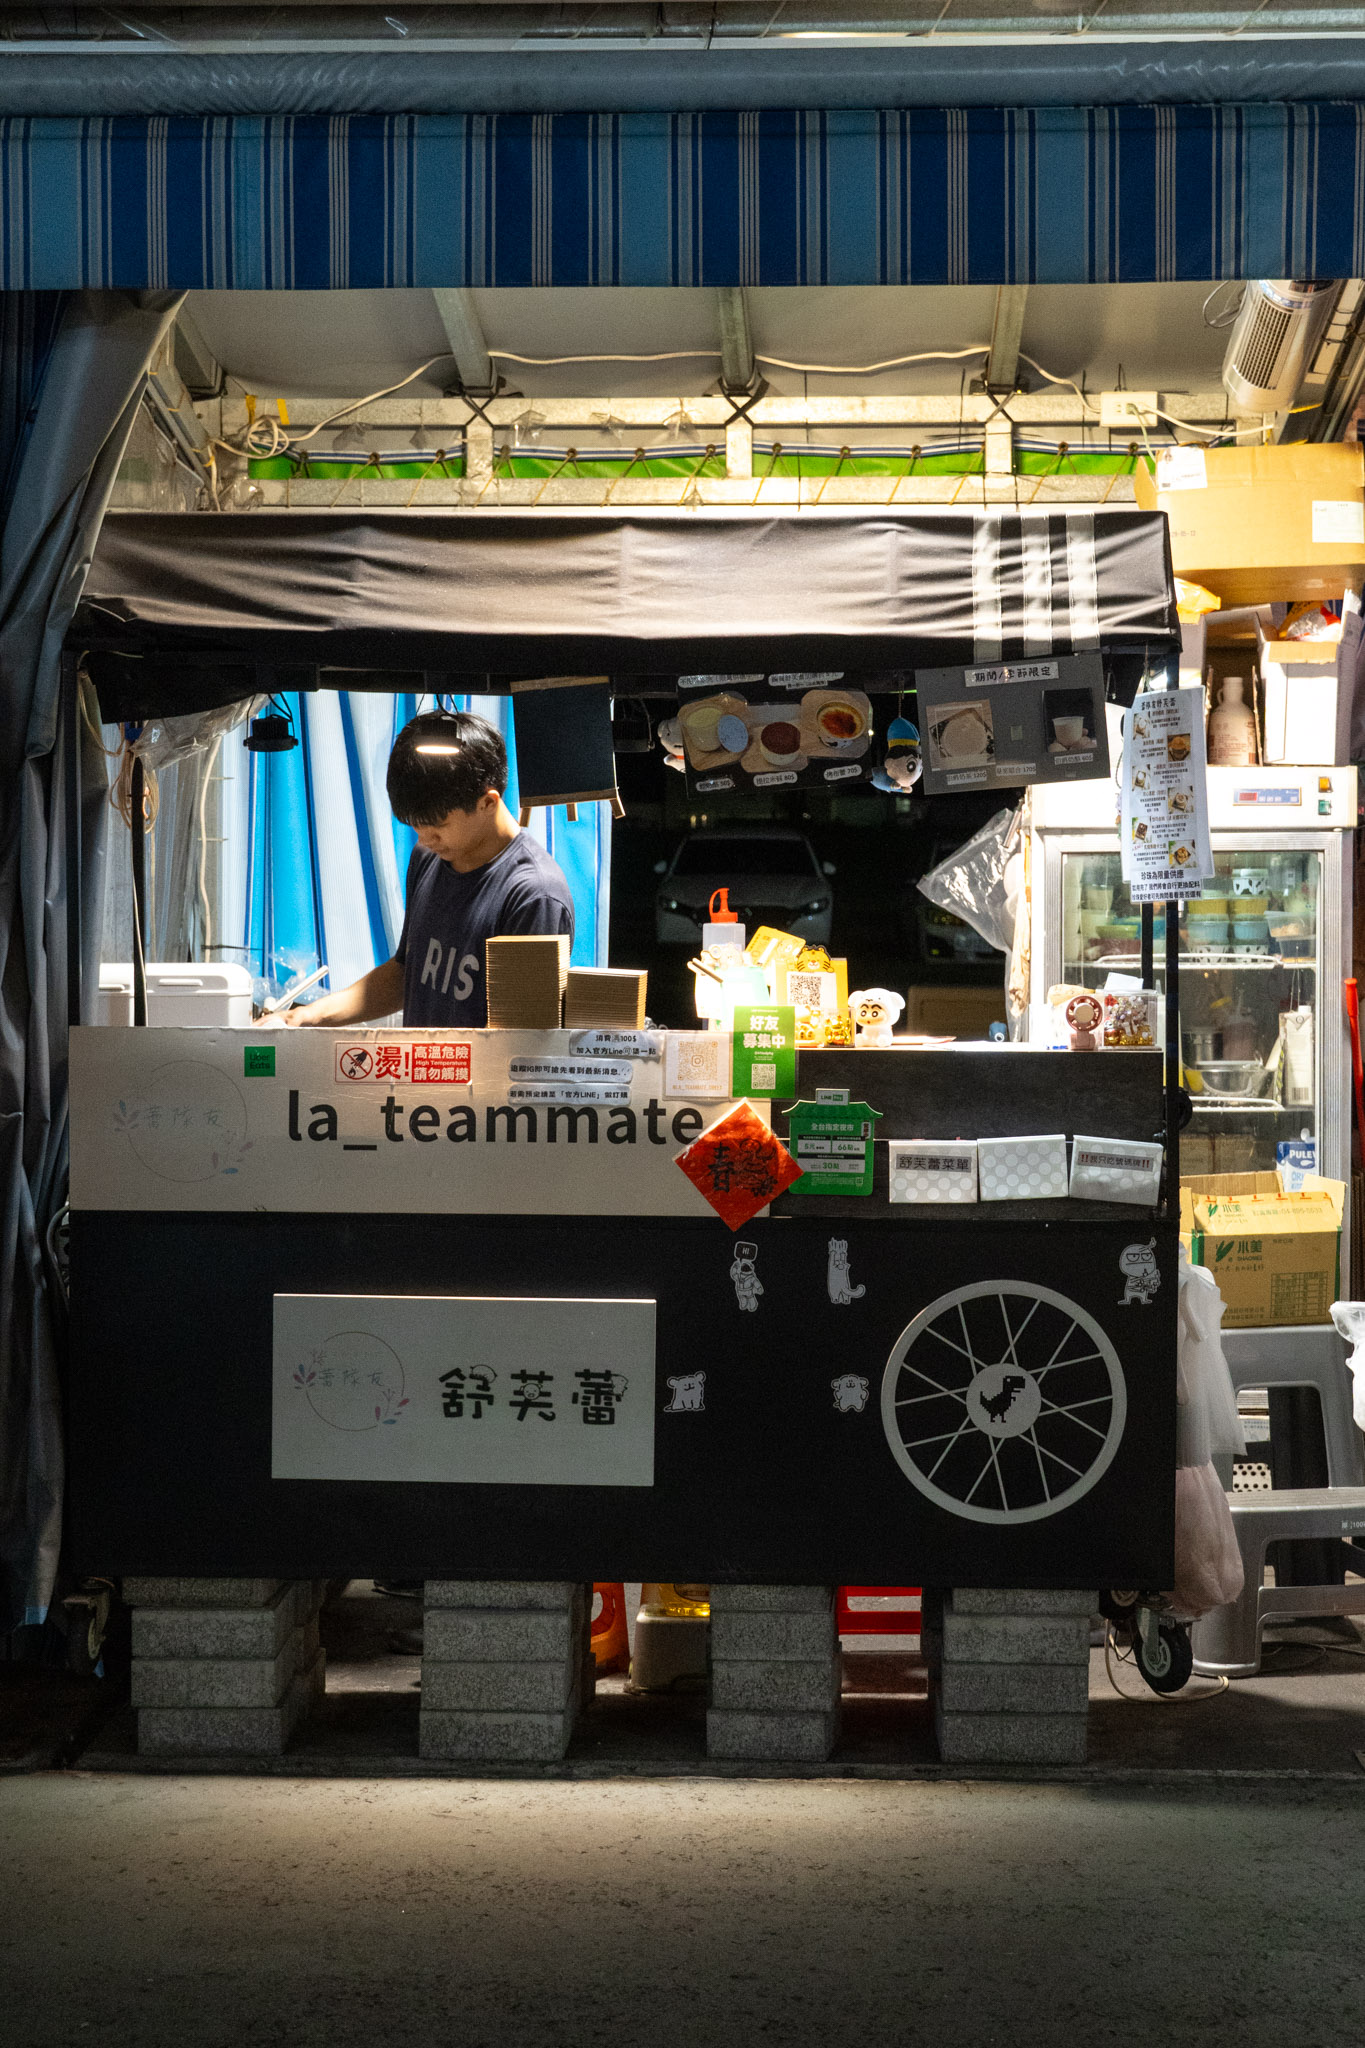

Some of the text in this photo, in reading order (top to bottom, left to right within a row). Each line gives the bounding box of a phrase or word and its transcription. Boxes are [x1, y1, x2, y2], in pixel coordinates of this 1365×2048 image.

[749, 1015, 779, 1031] 好友
[743, 1033, 786, 1049] 募集中
[250, 1053, 270, 1061] Uber
[375, 1045, 469, 1080] 燙! 高溫危險
[250, 1061, 271, 1069] Eats
[413, 1067, 469, 1081] 請勿觸摸
[288, 1089, 704, 1151] la_teammate
[899, 1156, 970, 1171] 舒芙蕾菜單
[742, 1247, 750, 1255] HI
[439, 1364, 628, 1425] 舒芙蕾
